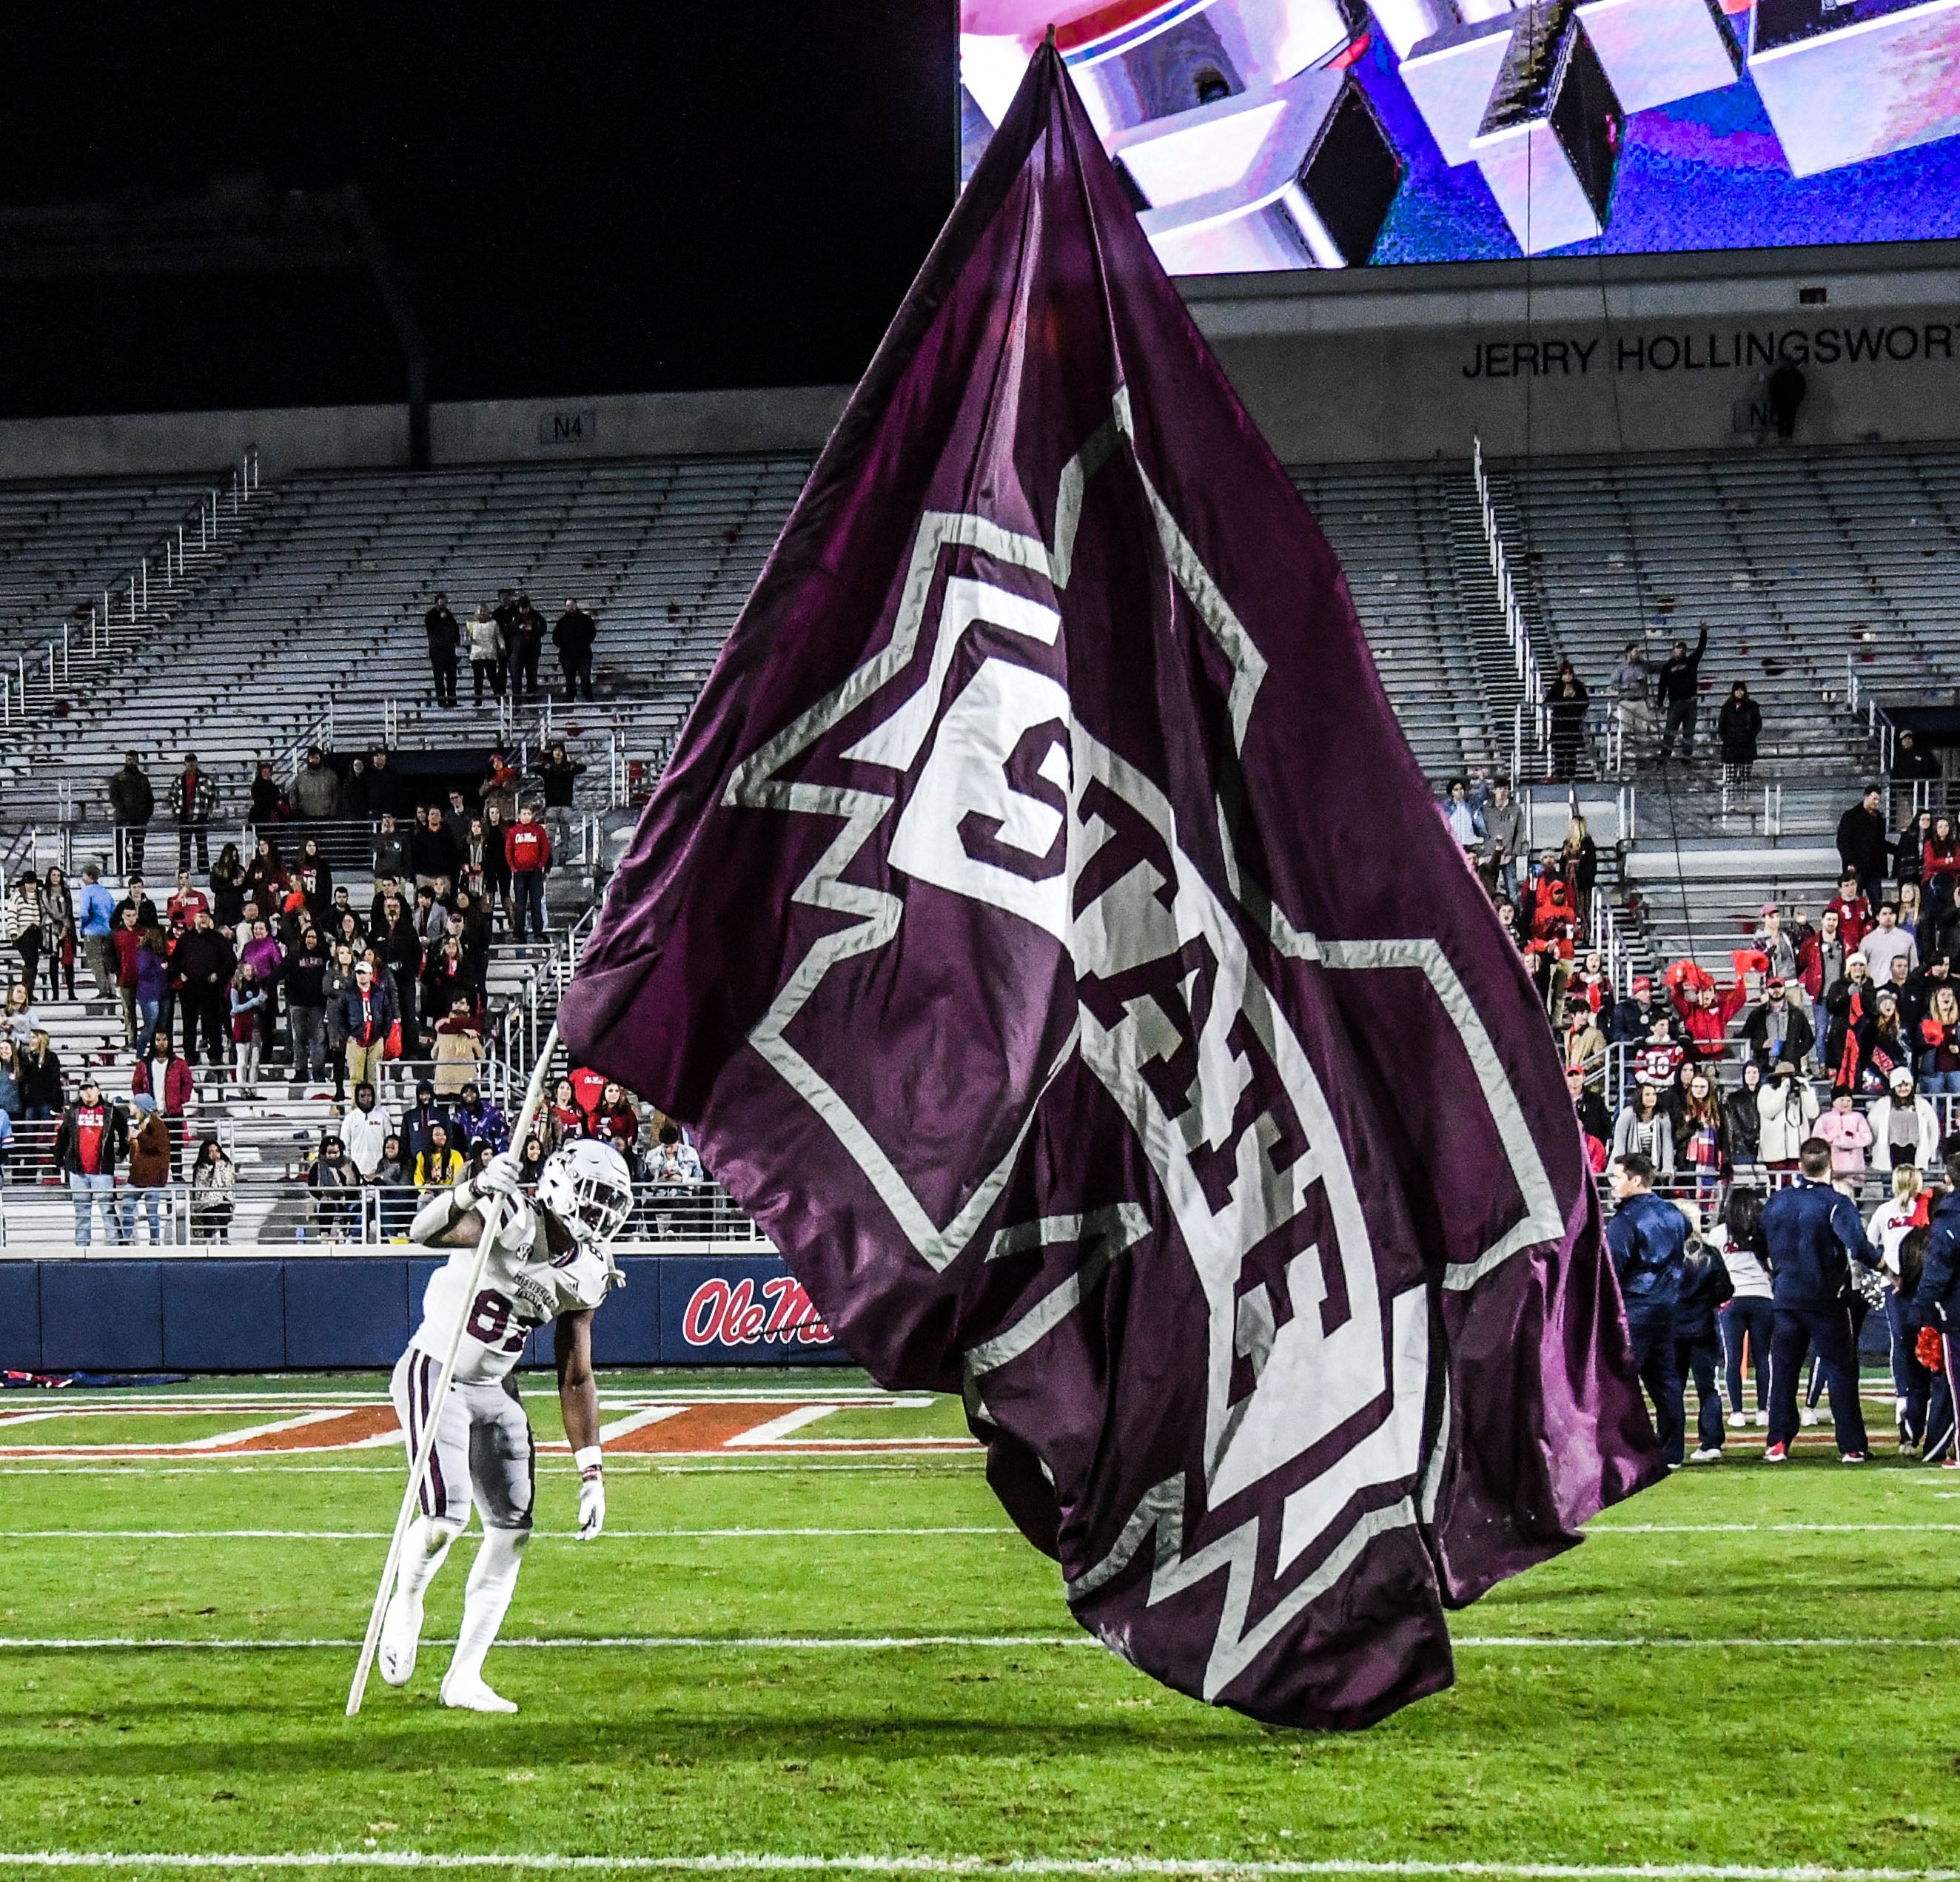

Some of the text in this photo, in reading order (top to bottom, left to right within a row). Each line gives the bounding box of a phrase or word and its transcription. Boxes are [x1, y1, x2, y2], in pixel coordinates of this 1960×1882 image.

[1462, 323, 1960, 378] JERRY HOLLINGSWOR
[554, 415, 583, 440] N4
[682, 1277, 834, 1346] Ole Mi
